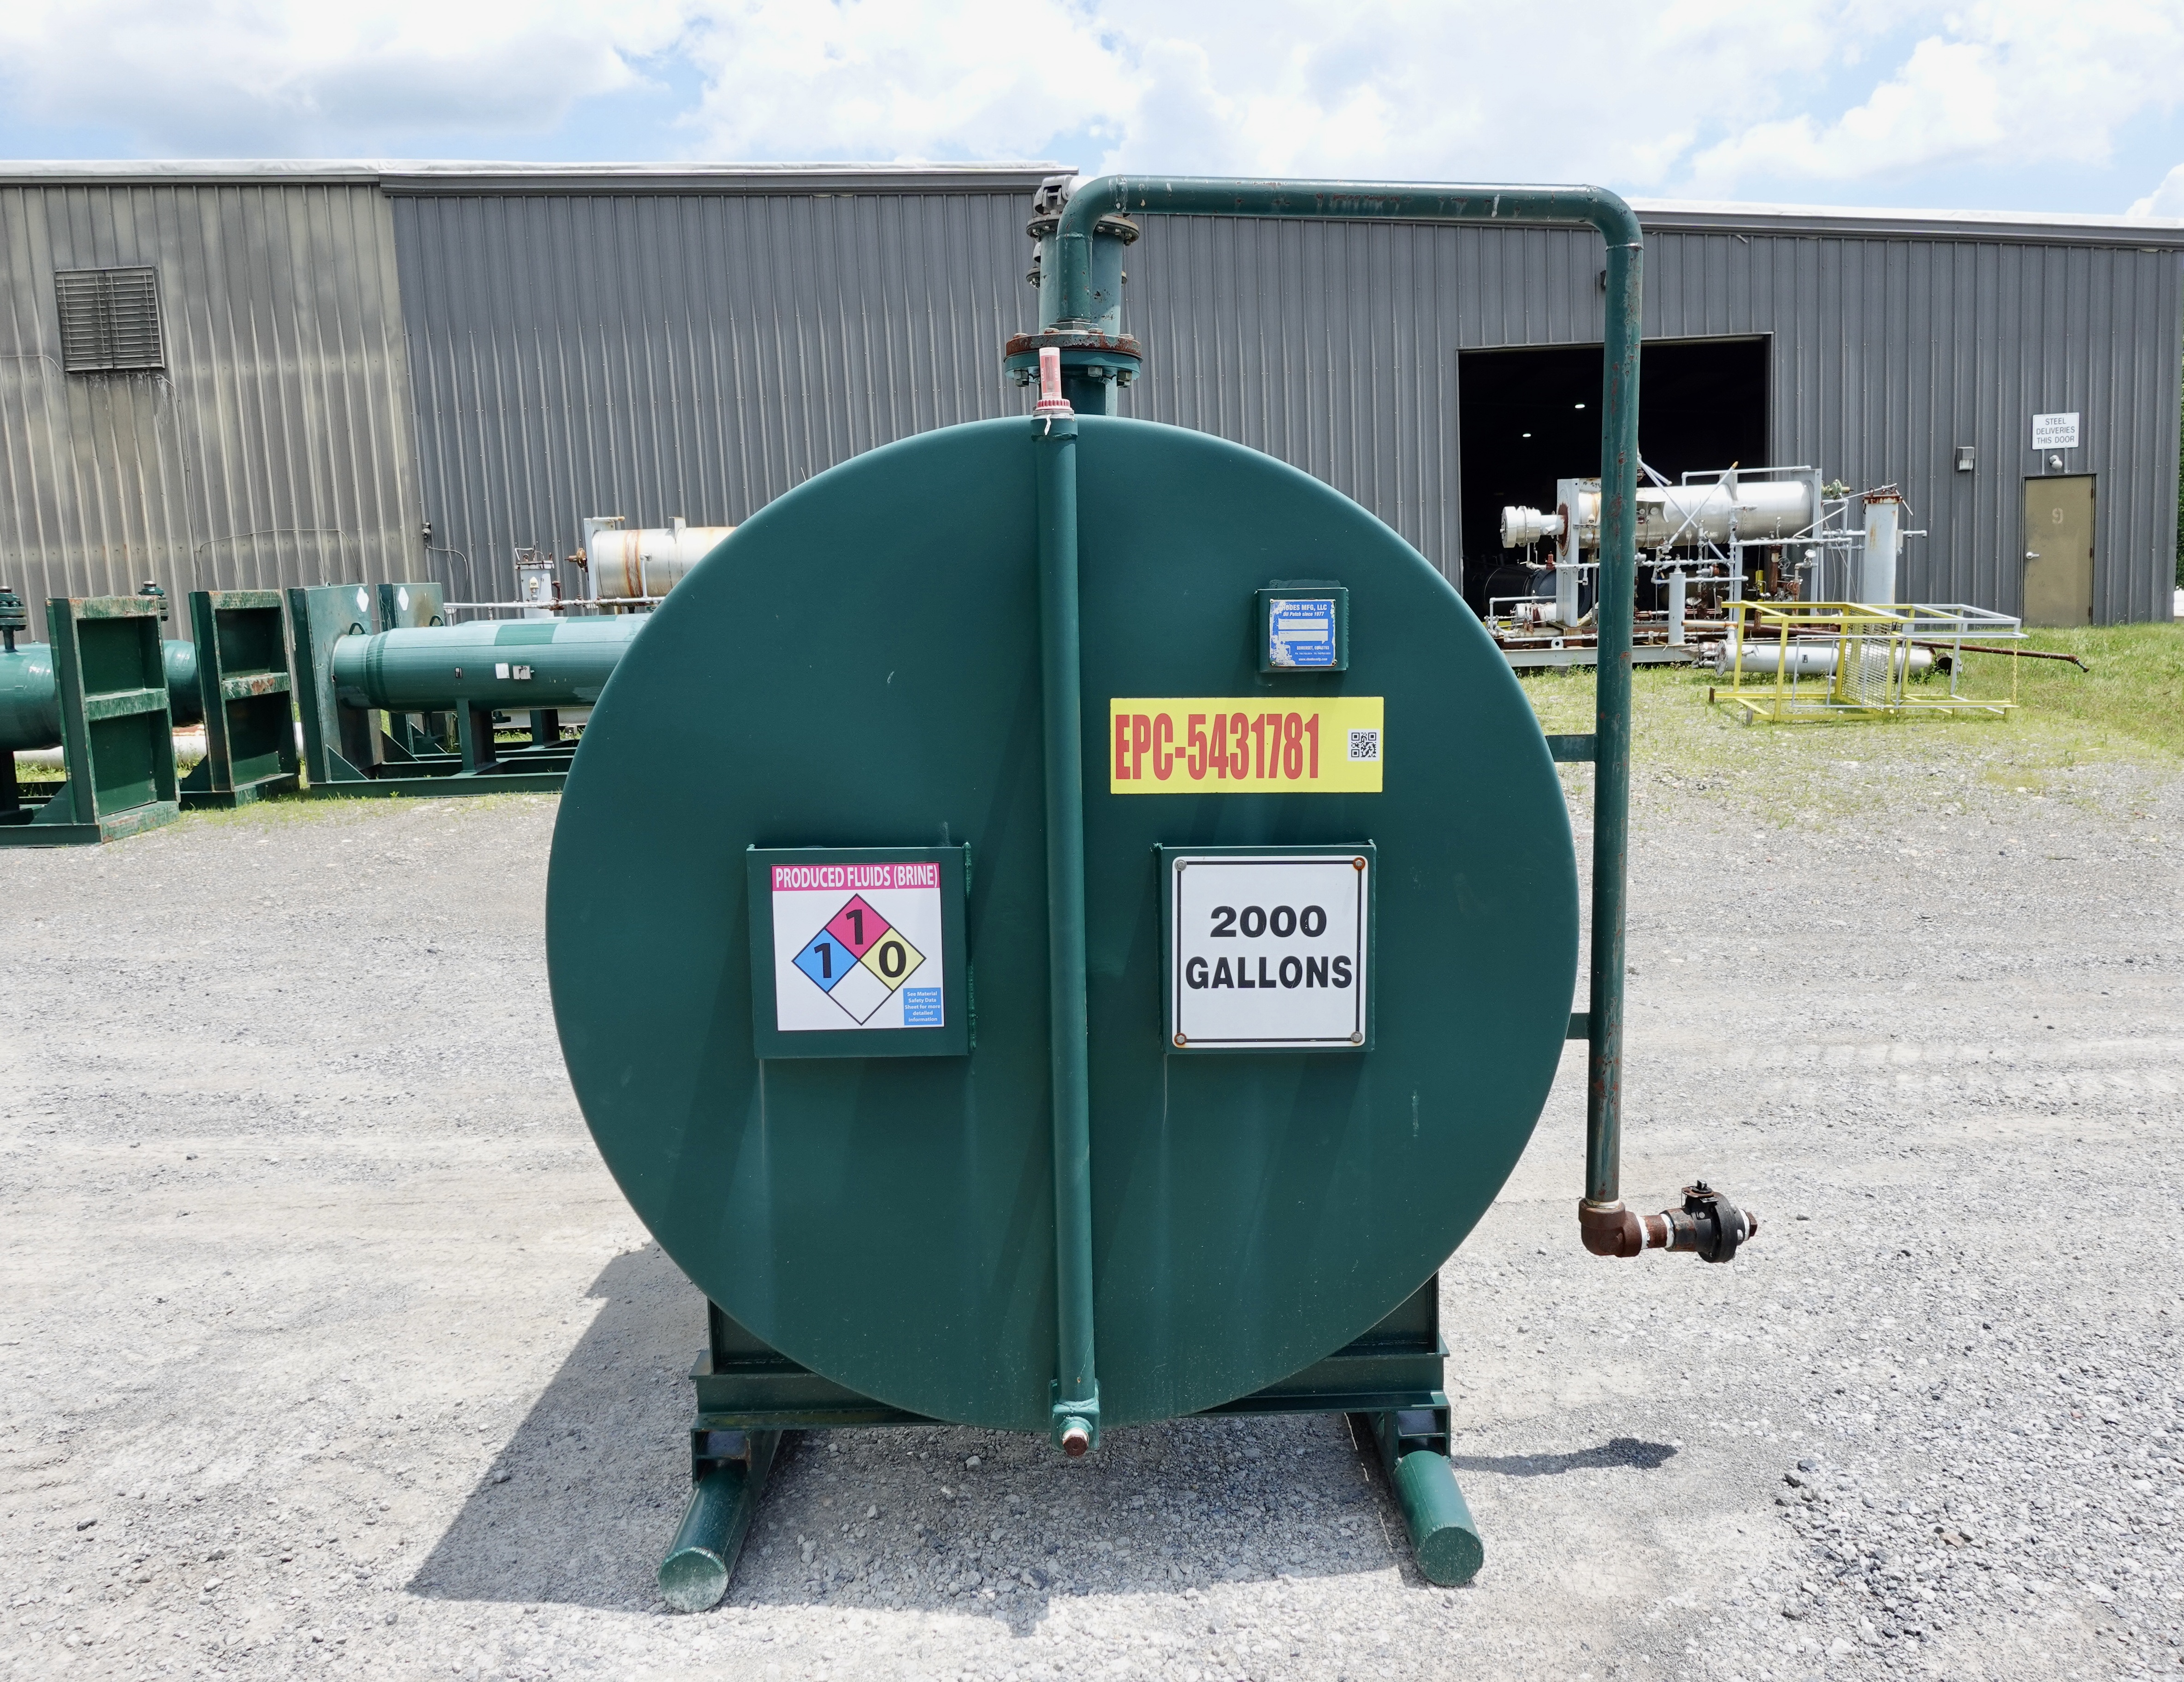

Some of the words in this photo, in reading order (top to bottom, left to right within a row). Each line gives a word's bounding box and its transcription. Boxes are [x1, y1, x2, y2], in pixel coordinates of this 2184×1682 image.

[2036, 426, 2075, 435] DELIVERIES
[2052, 508, 2063, 524] 9
[1115, 712, 1319, 781] EPC-5431781
[775, 867, 845, 888] PRODUCED
[847, 866, 891, 887] FLUIDS
[894, 865, 938, 889] (BRINE)
[846, 909, 864, 945] 1
[1210, 905, 1327, 938] 2000
[814, 942, 832, 978] 1
[879, 941, 906, 977] 0
[1185, 955, 1352, 989] GALLONS
